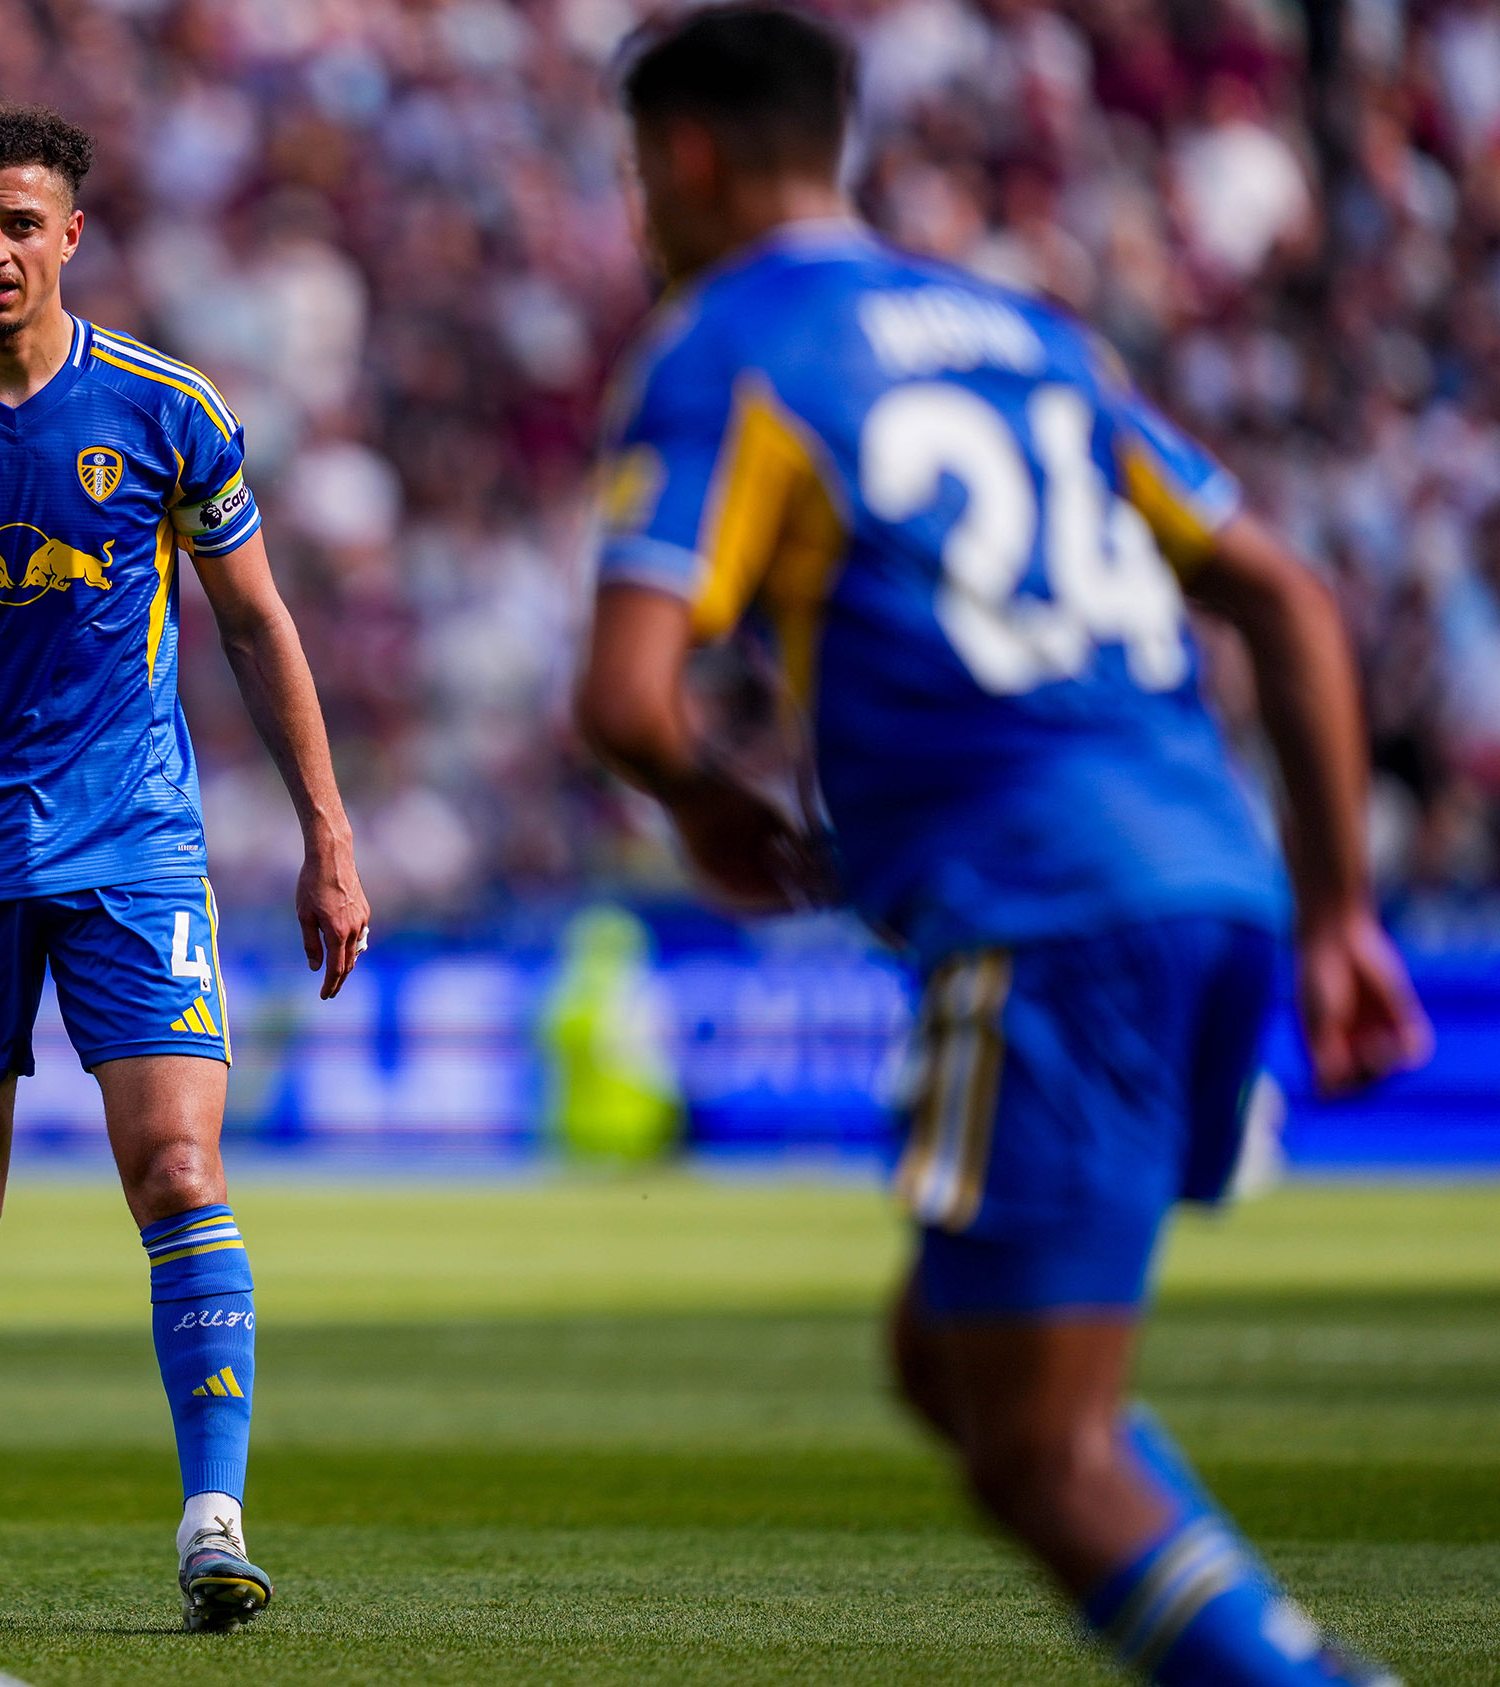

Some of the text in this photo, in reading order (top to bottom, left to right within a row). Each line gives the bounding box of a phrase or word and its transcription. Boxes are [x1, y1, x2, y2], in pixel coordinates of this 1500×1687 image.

[857, 381, 1188, 697] 24
[171, 912, 212, 992] 4
[173, 1310, 254, 1332] LUFC
